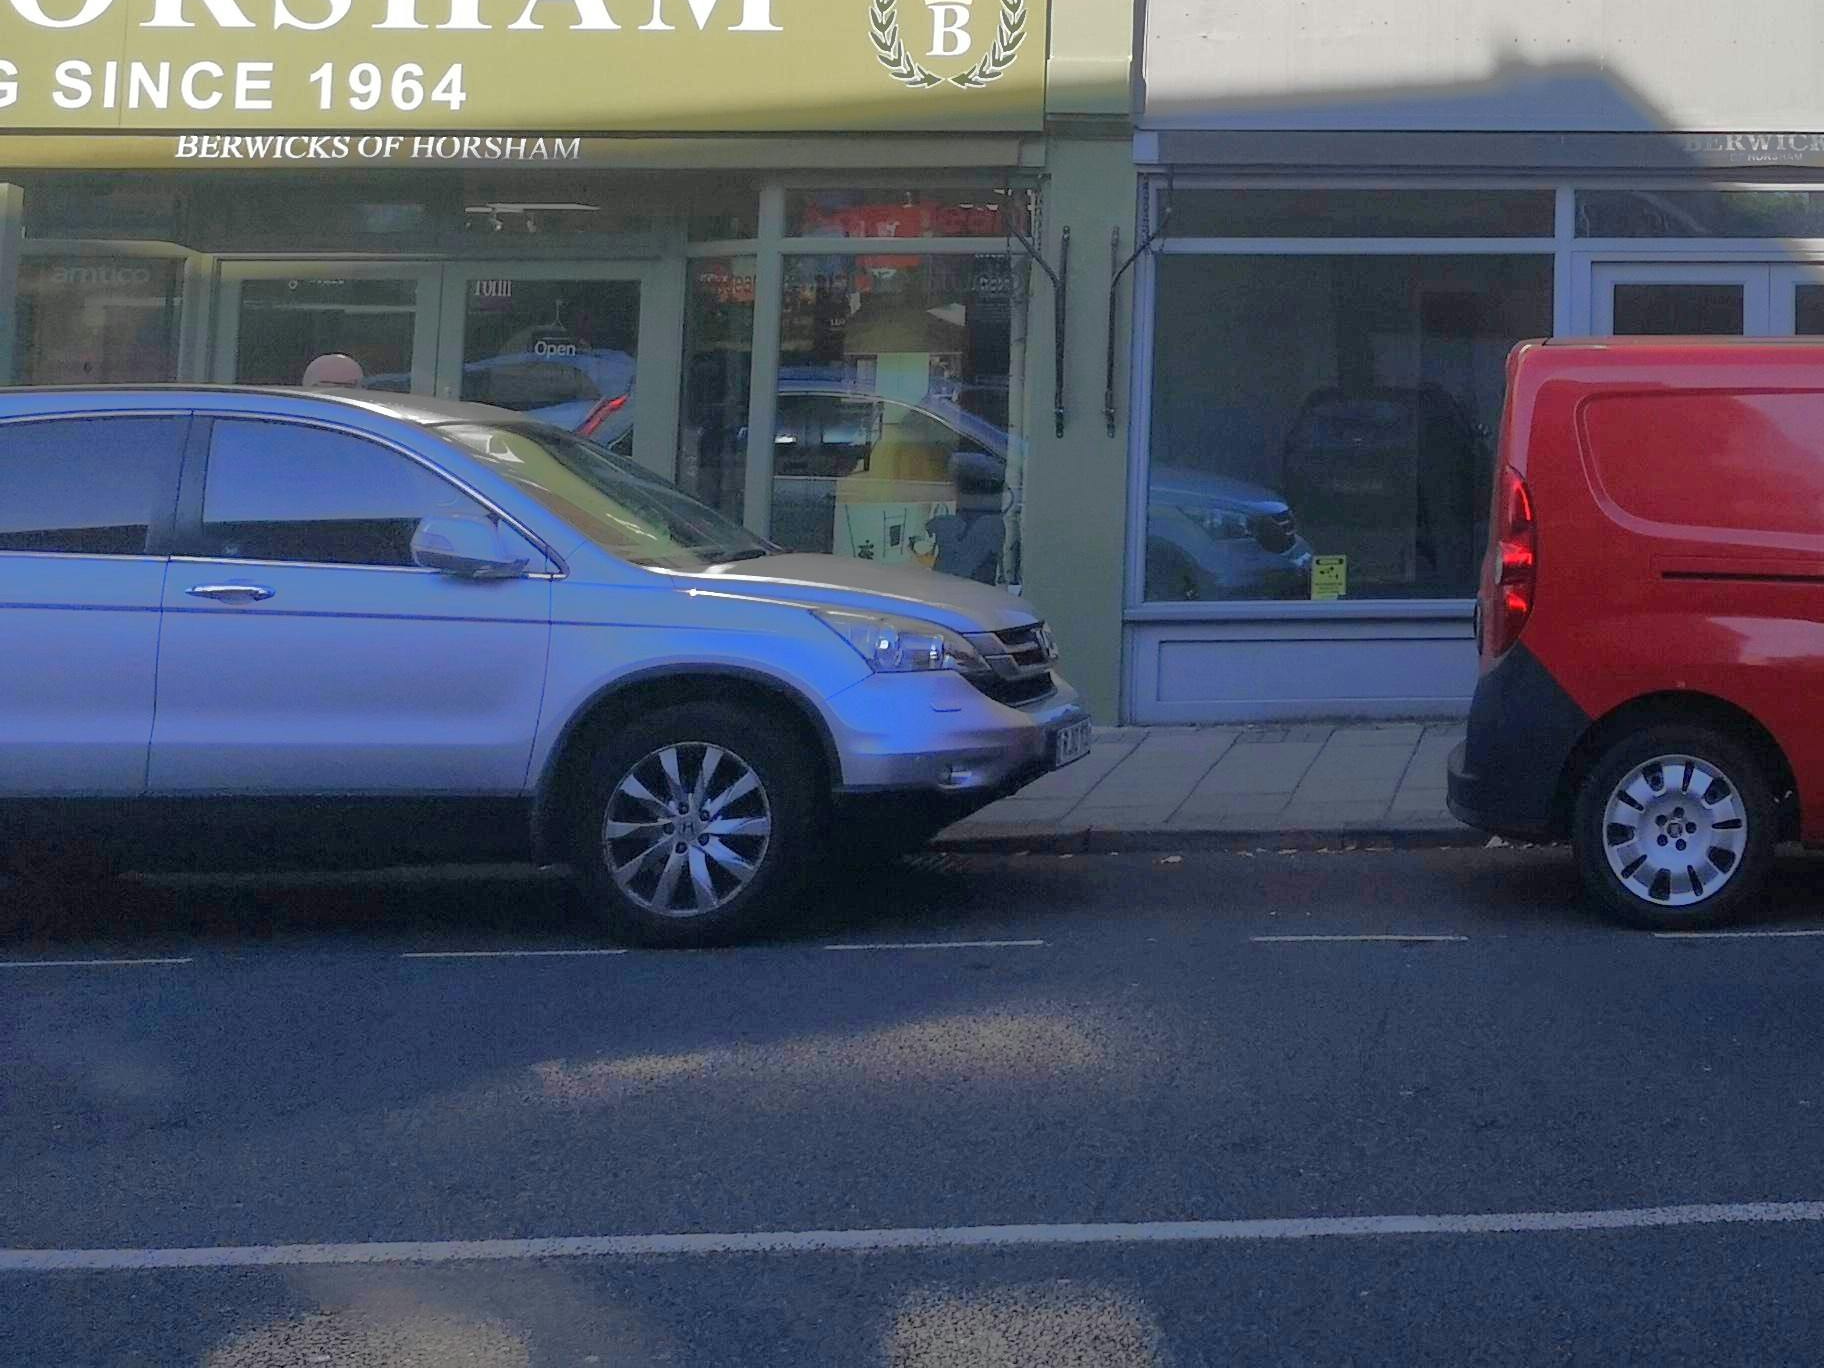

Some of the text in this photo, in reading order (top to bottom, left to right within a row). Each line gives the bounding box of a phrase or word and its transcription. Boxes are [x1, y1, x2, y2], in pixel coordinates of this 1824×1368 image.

[925, 4, 972, 56] B
[52, 60, 273, 110] SINCE
[310, 62, 466, 111] 1964
[174, 135, 582, 161] BERWICKS OF HORSHAM
[534, 340, 577, 357] Open
